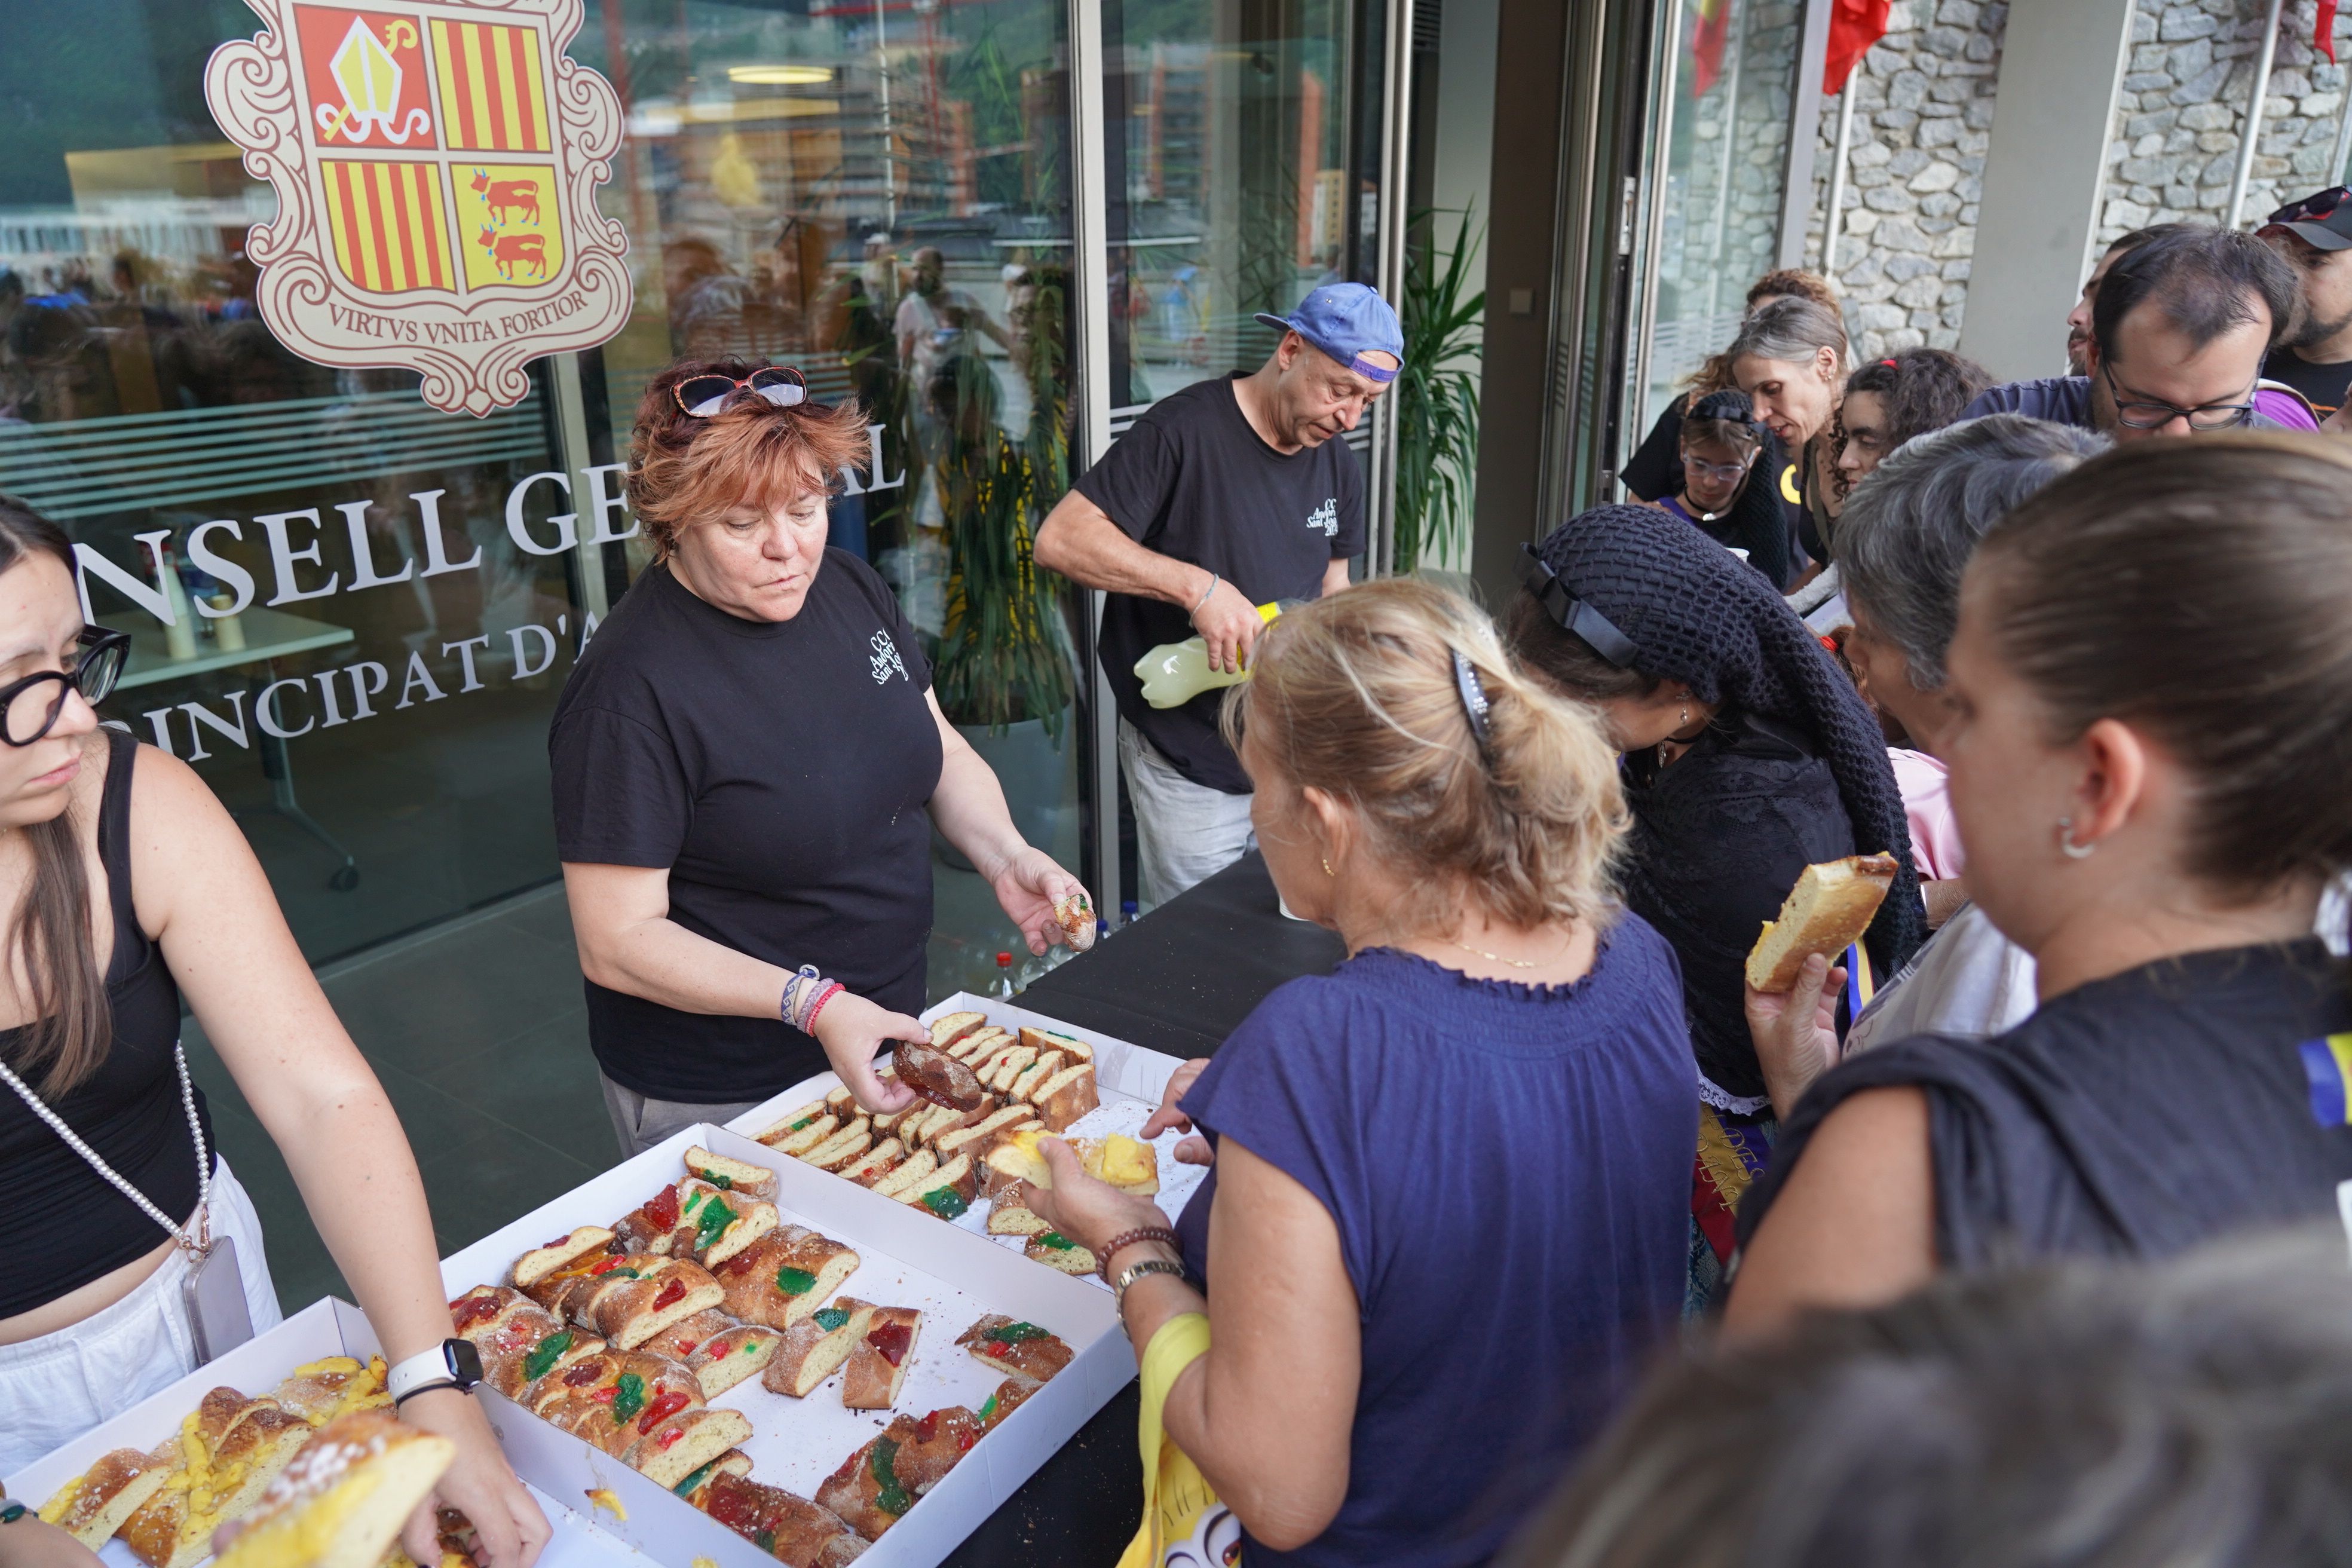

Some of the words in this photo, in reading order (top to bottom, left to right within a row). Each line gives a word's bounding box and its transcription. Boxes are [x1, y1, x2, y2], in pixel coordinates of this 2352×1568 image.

[328, 302, 418, 343] VIRTVS
[424, 320, 498, 345] VNITA
[499, 290, 589, 338] FORTIOR
[71, 489, 482, 626] NSELL
[97, 633, 489, 762] INCIPAT
[871, 663, 894, 685] Sant
